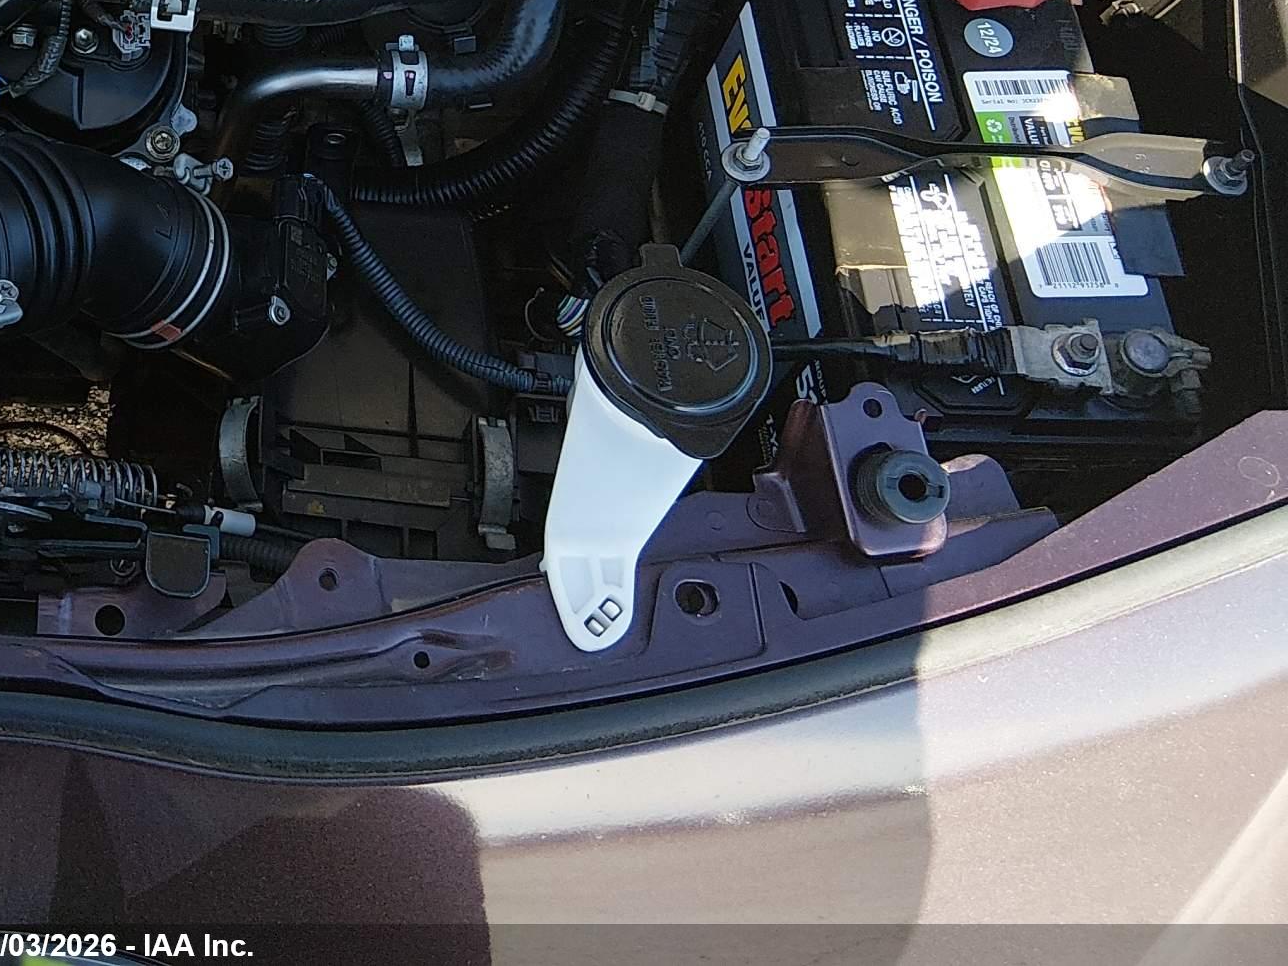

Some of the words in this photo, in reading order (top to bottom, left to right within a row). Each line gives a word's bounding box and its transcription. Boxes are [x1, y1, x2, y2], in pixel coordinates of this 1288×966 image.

[871, 30, 881, 41] NO
[912, 38, 927, 46] /
[977, 22, 1002, 54] 12/24
[915, 48, 943, 103] POISON
[881, 70, 897, 105] SULFURIC
[890, 107, 902, 124] ACID
[978, 286, 989, 303] CAPS
[985, 281, 996, 302] REACH
[991, 304, 999, 314] OF
